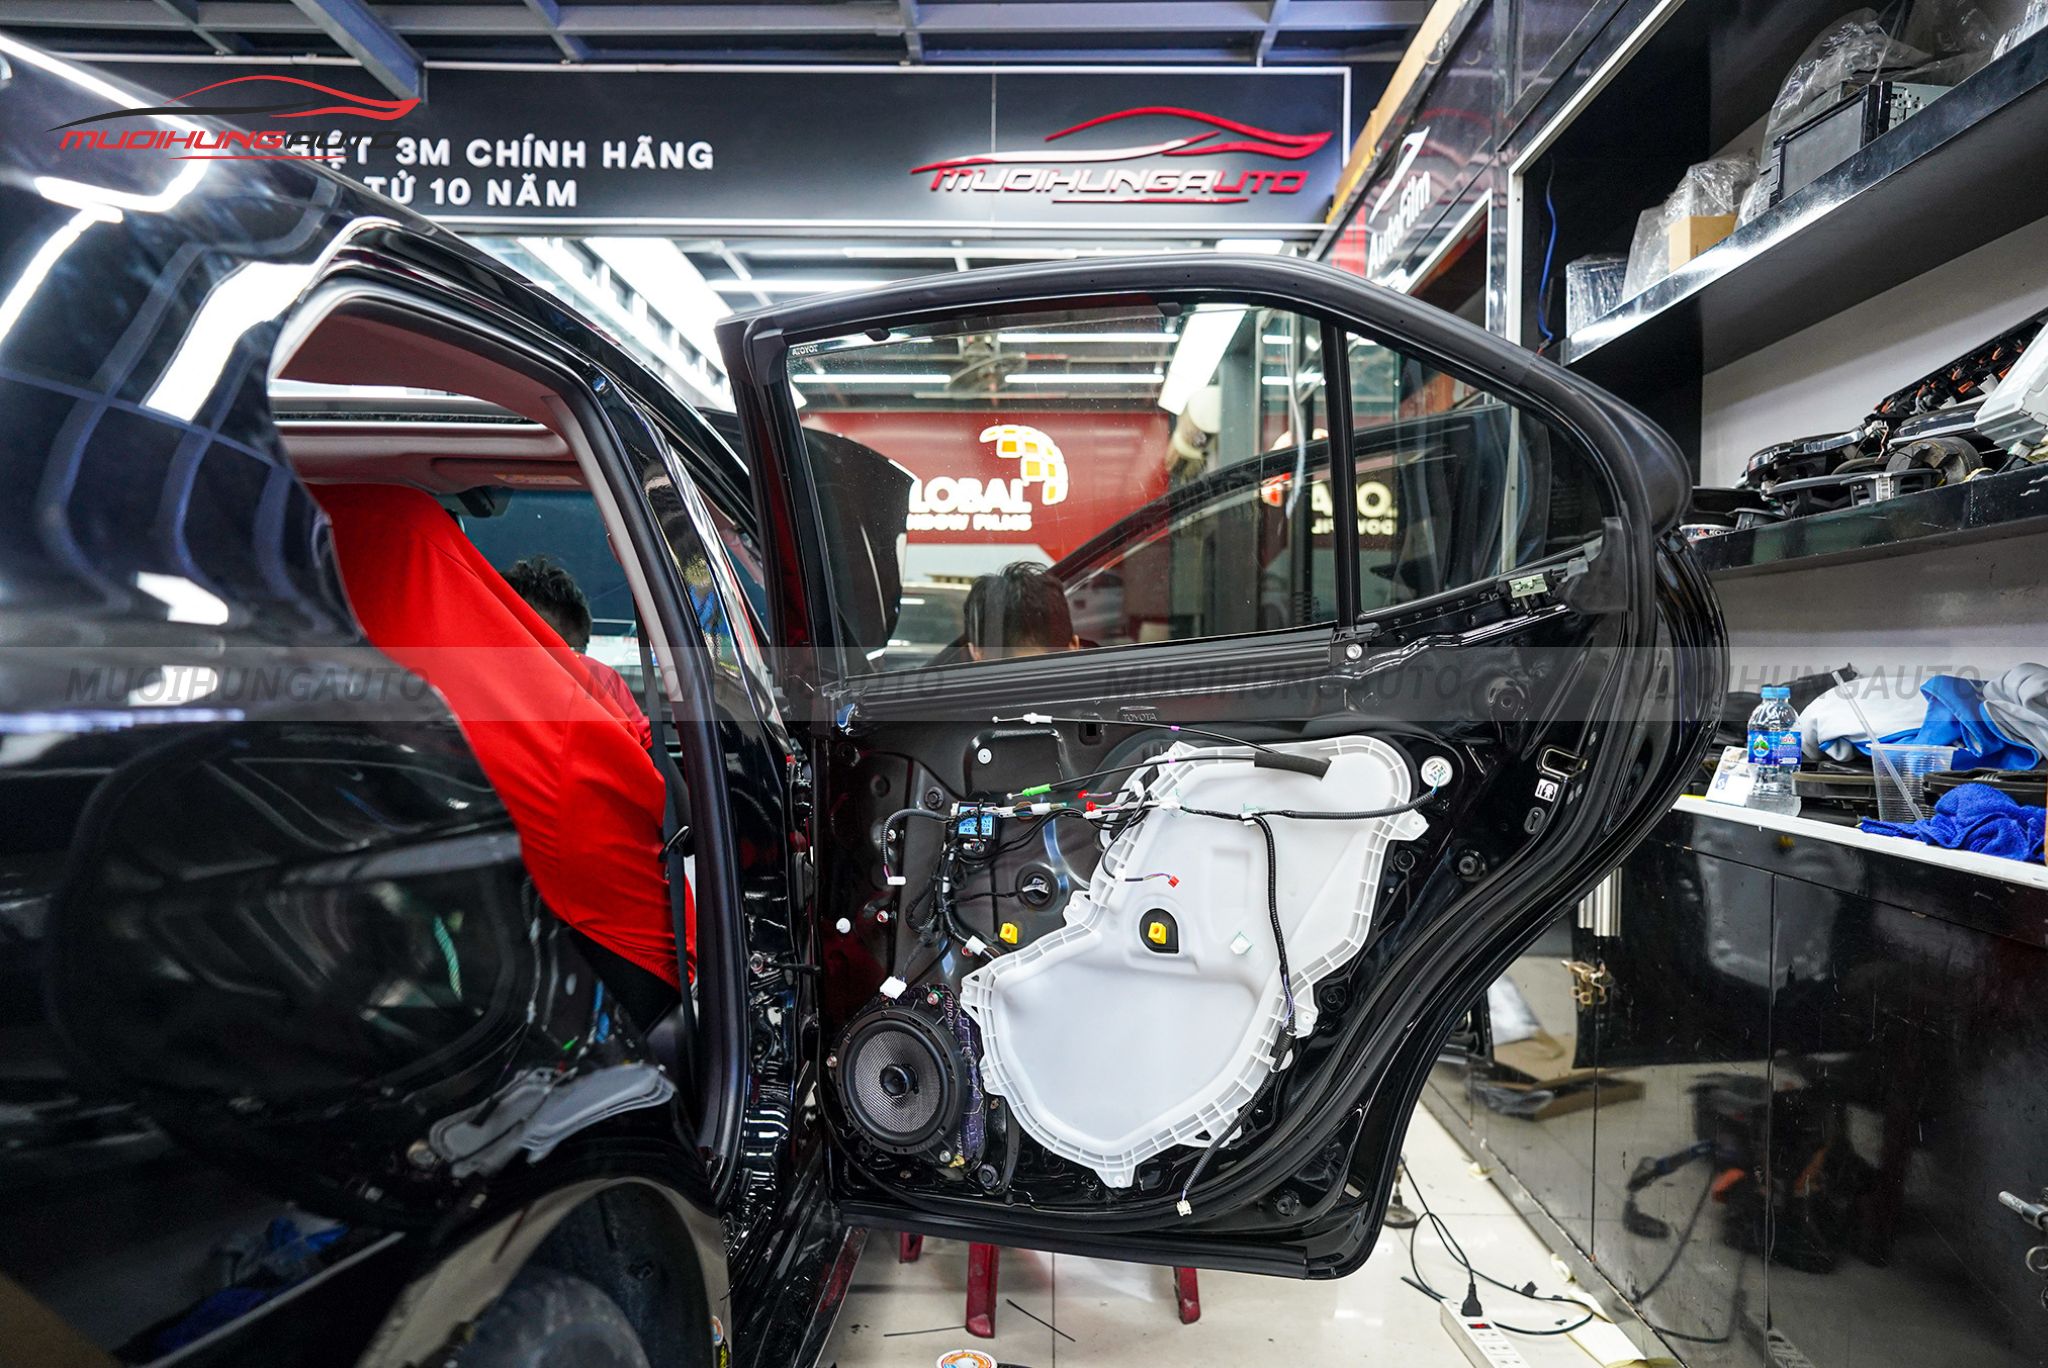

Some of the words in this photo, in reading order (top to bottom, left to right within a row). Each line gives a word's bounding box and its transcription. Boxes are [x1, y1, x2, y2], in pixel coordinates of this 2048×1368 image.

[395, 136, 450, 166] 3M
[465, 133, 587, 168] CHÍNH
[602, 135, 714, 170] HÃNG
[429, 177, 472, 206] 10
[486, 173, 578, 208] NĂM
[930, 168, 1309, 194] MUOIHUNGAUTO
[908, 476, 1033, 513] LOBAL
[1122, 713, 1158, 722] TOYOTA
